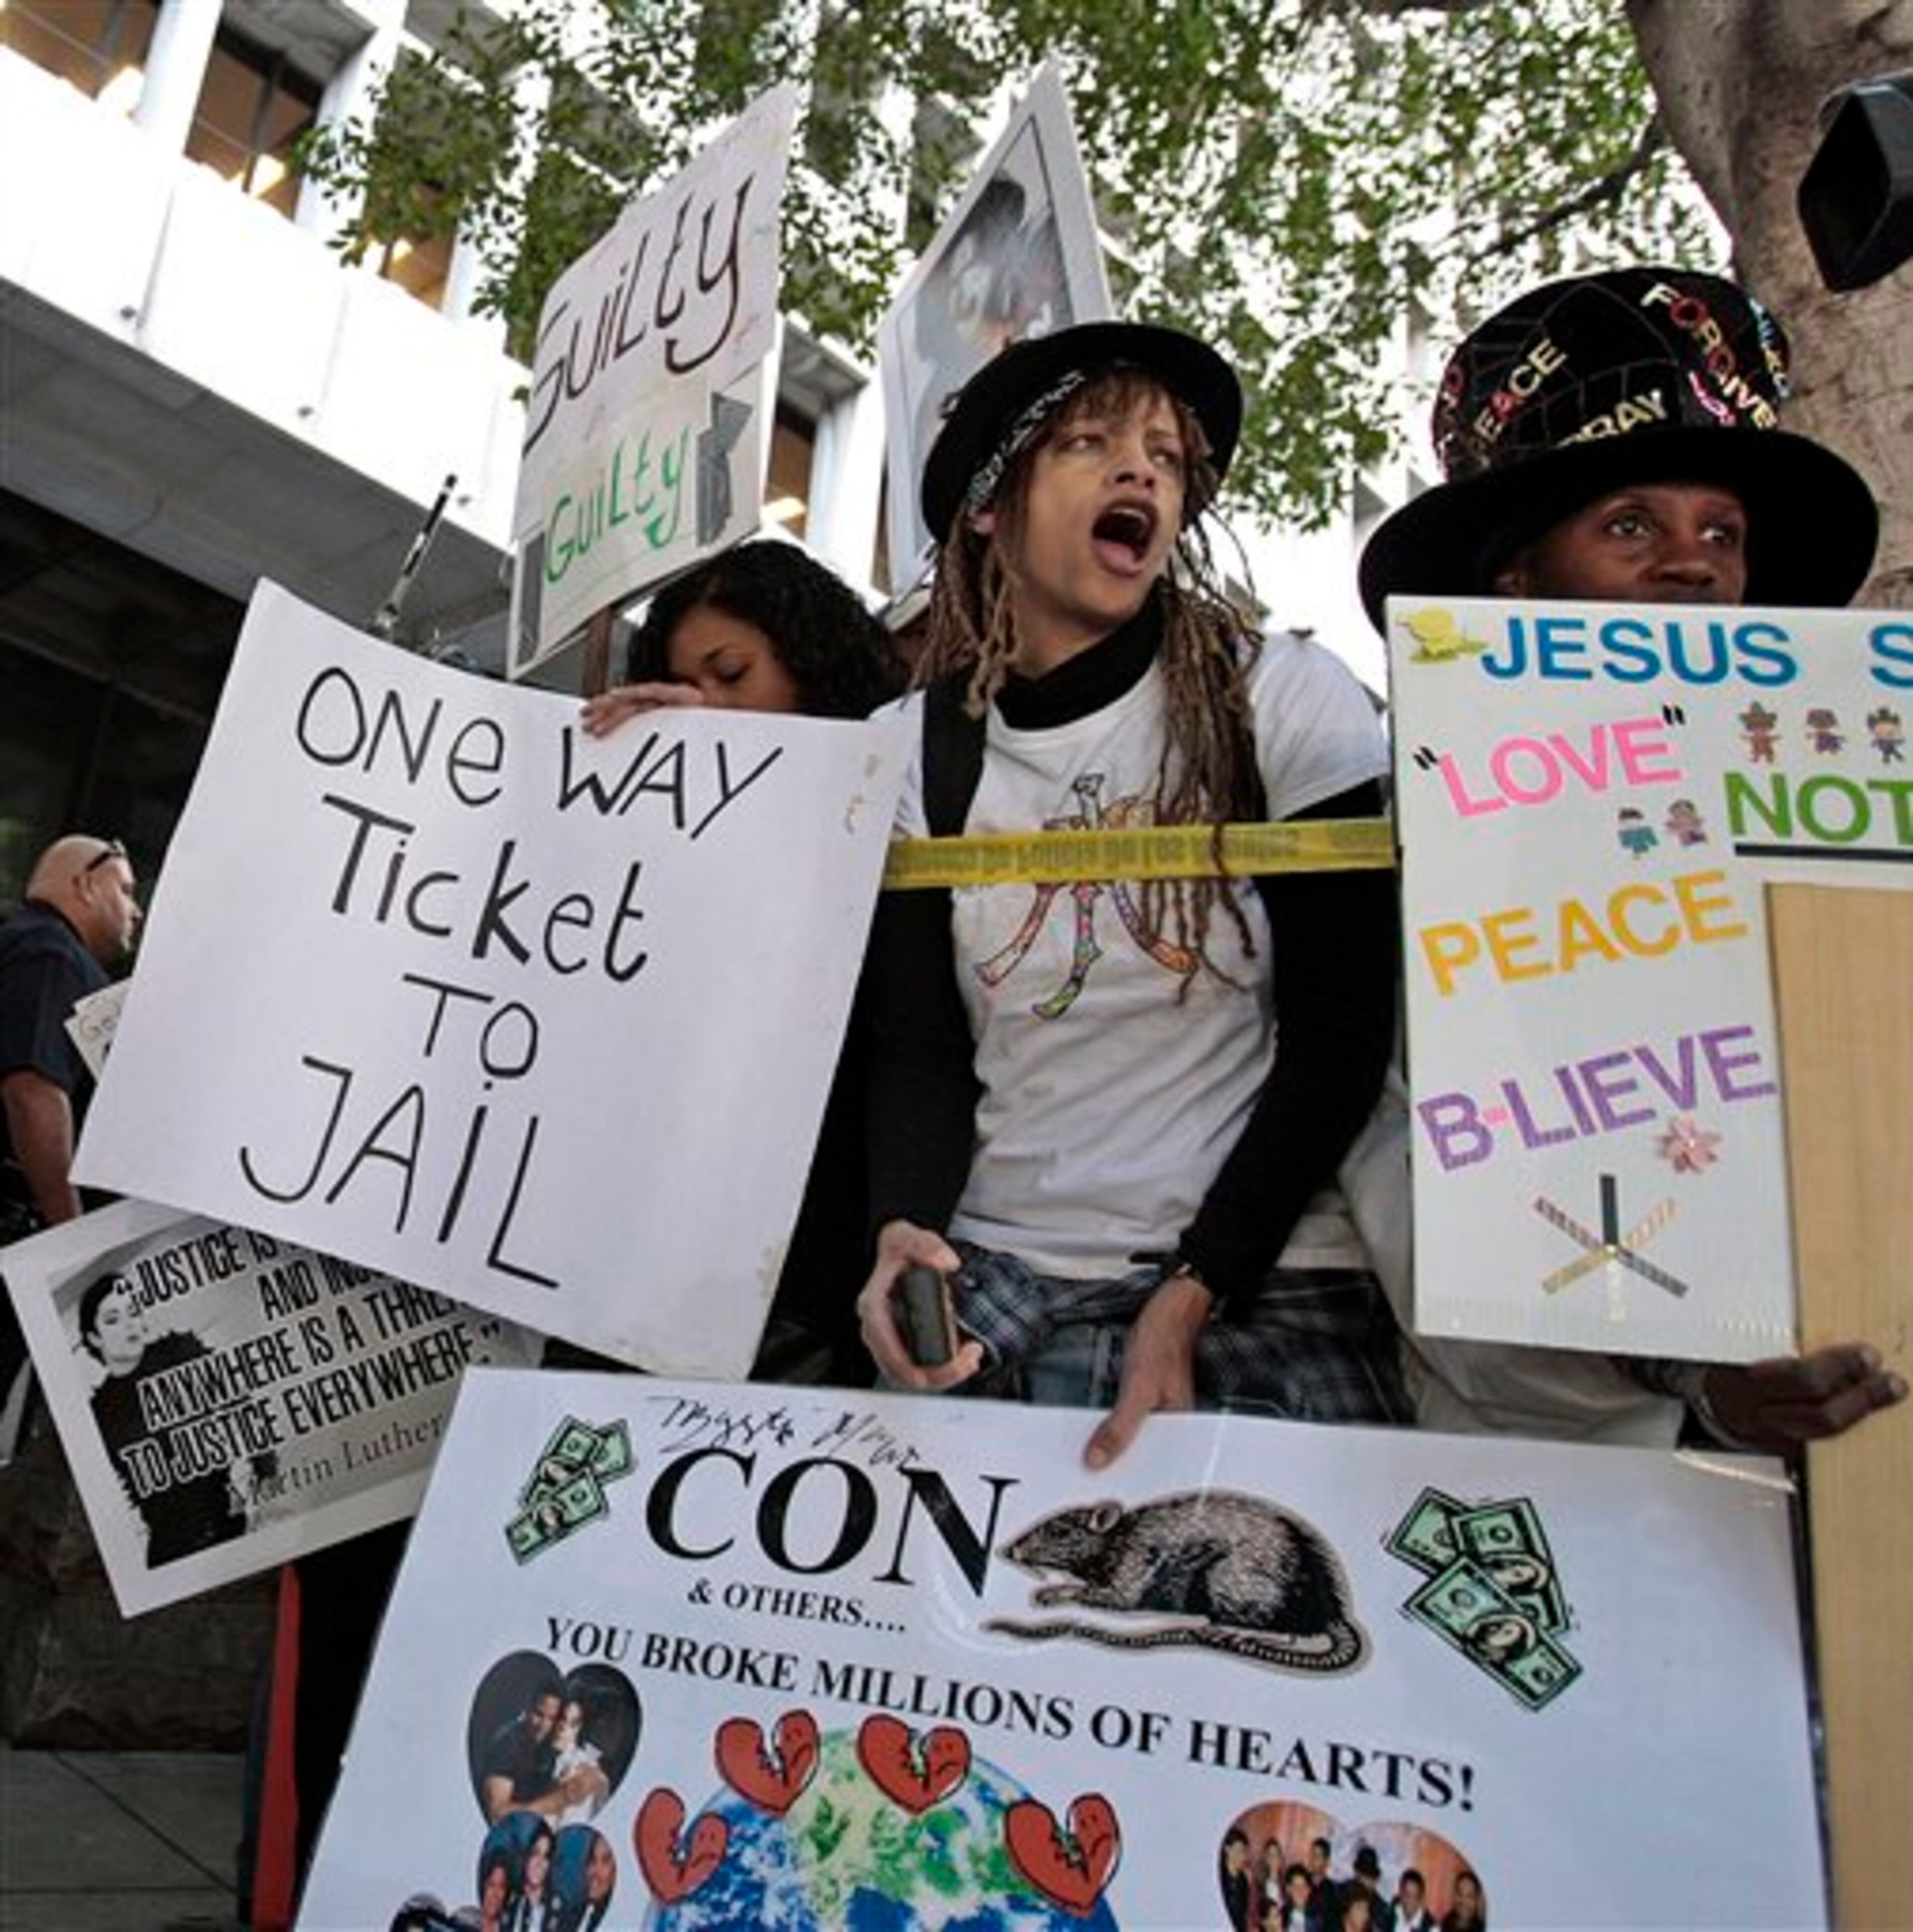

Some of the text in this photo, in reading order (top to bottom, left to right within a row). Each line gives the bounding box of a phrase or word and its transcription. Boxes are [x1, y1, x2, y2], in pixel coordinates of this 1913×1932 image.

[1640, 283, 1777, 429] FORGIVE
[1482, 617, 1797, 686] JESUS
[557, 725, 784, 840] WAY
[1412, 703, 1686, 819] "LOVE"
[1723, 771, 1913, 845] NOT
[322, 794, 649, 982] Ticket
[1417, 869, 1748, 997] PEACE
[404, 973, 538, 1078] TO
[1416, 1024, 1777, 1171] B-LIEVE
[257, 1263, 319, 1321] AND
[137, 1330, 302, 1433] ANYWHERE
[299, 1316, 335, 1368] IS
[336, 1305, 365, 1353] A
[122, 1444, 170, 1499] TO
[164, 1405, 284, 1486] JUSTICE
[342, 1413, 443, 1479] Luther
[646, 1447, 1021, 1598] CON
[687, 1578, 712, 1605] &
[547, 1616, 1476, 1812] YOU BROKE MILLIONS OF HEARTS!
